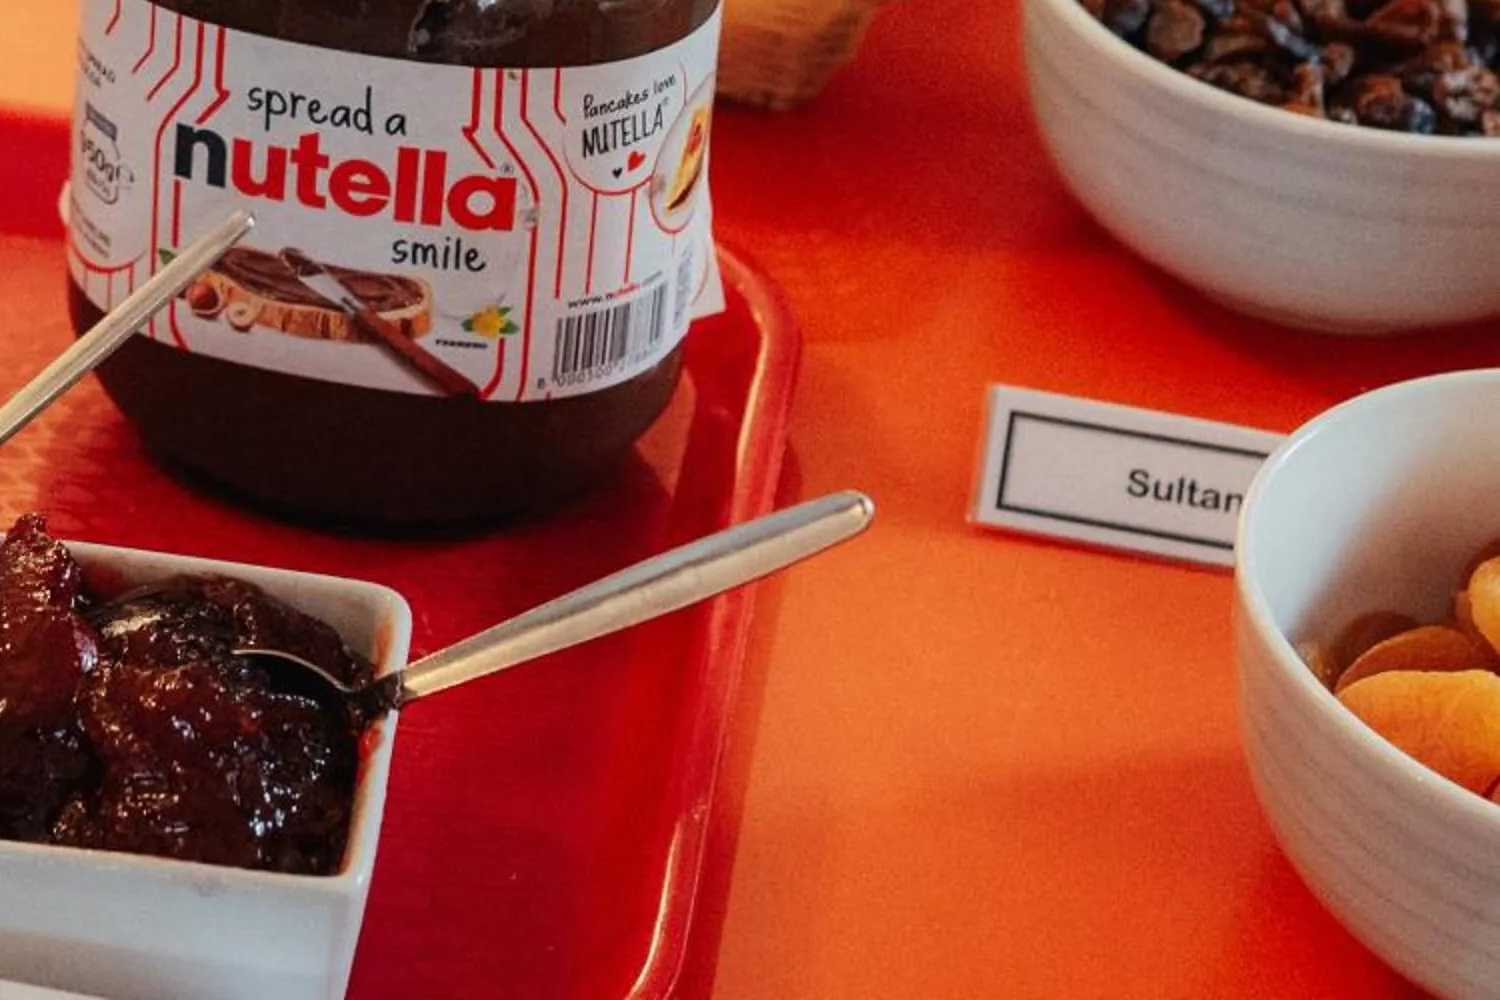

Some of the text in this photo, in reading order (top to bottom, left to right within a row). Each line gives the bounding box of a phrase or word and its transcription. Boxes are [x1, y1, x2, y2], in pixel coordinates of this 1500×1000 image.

[246, 85, 408, 136] spread a
[582, 74, 676, 120] Pancakes love
[582, 102, 663, 160] NUTELLA
[174, 122, 518, 232] nutella
[391, 236, 486, 273] smile
